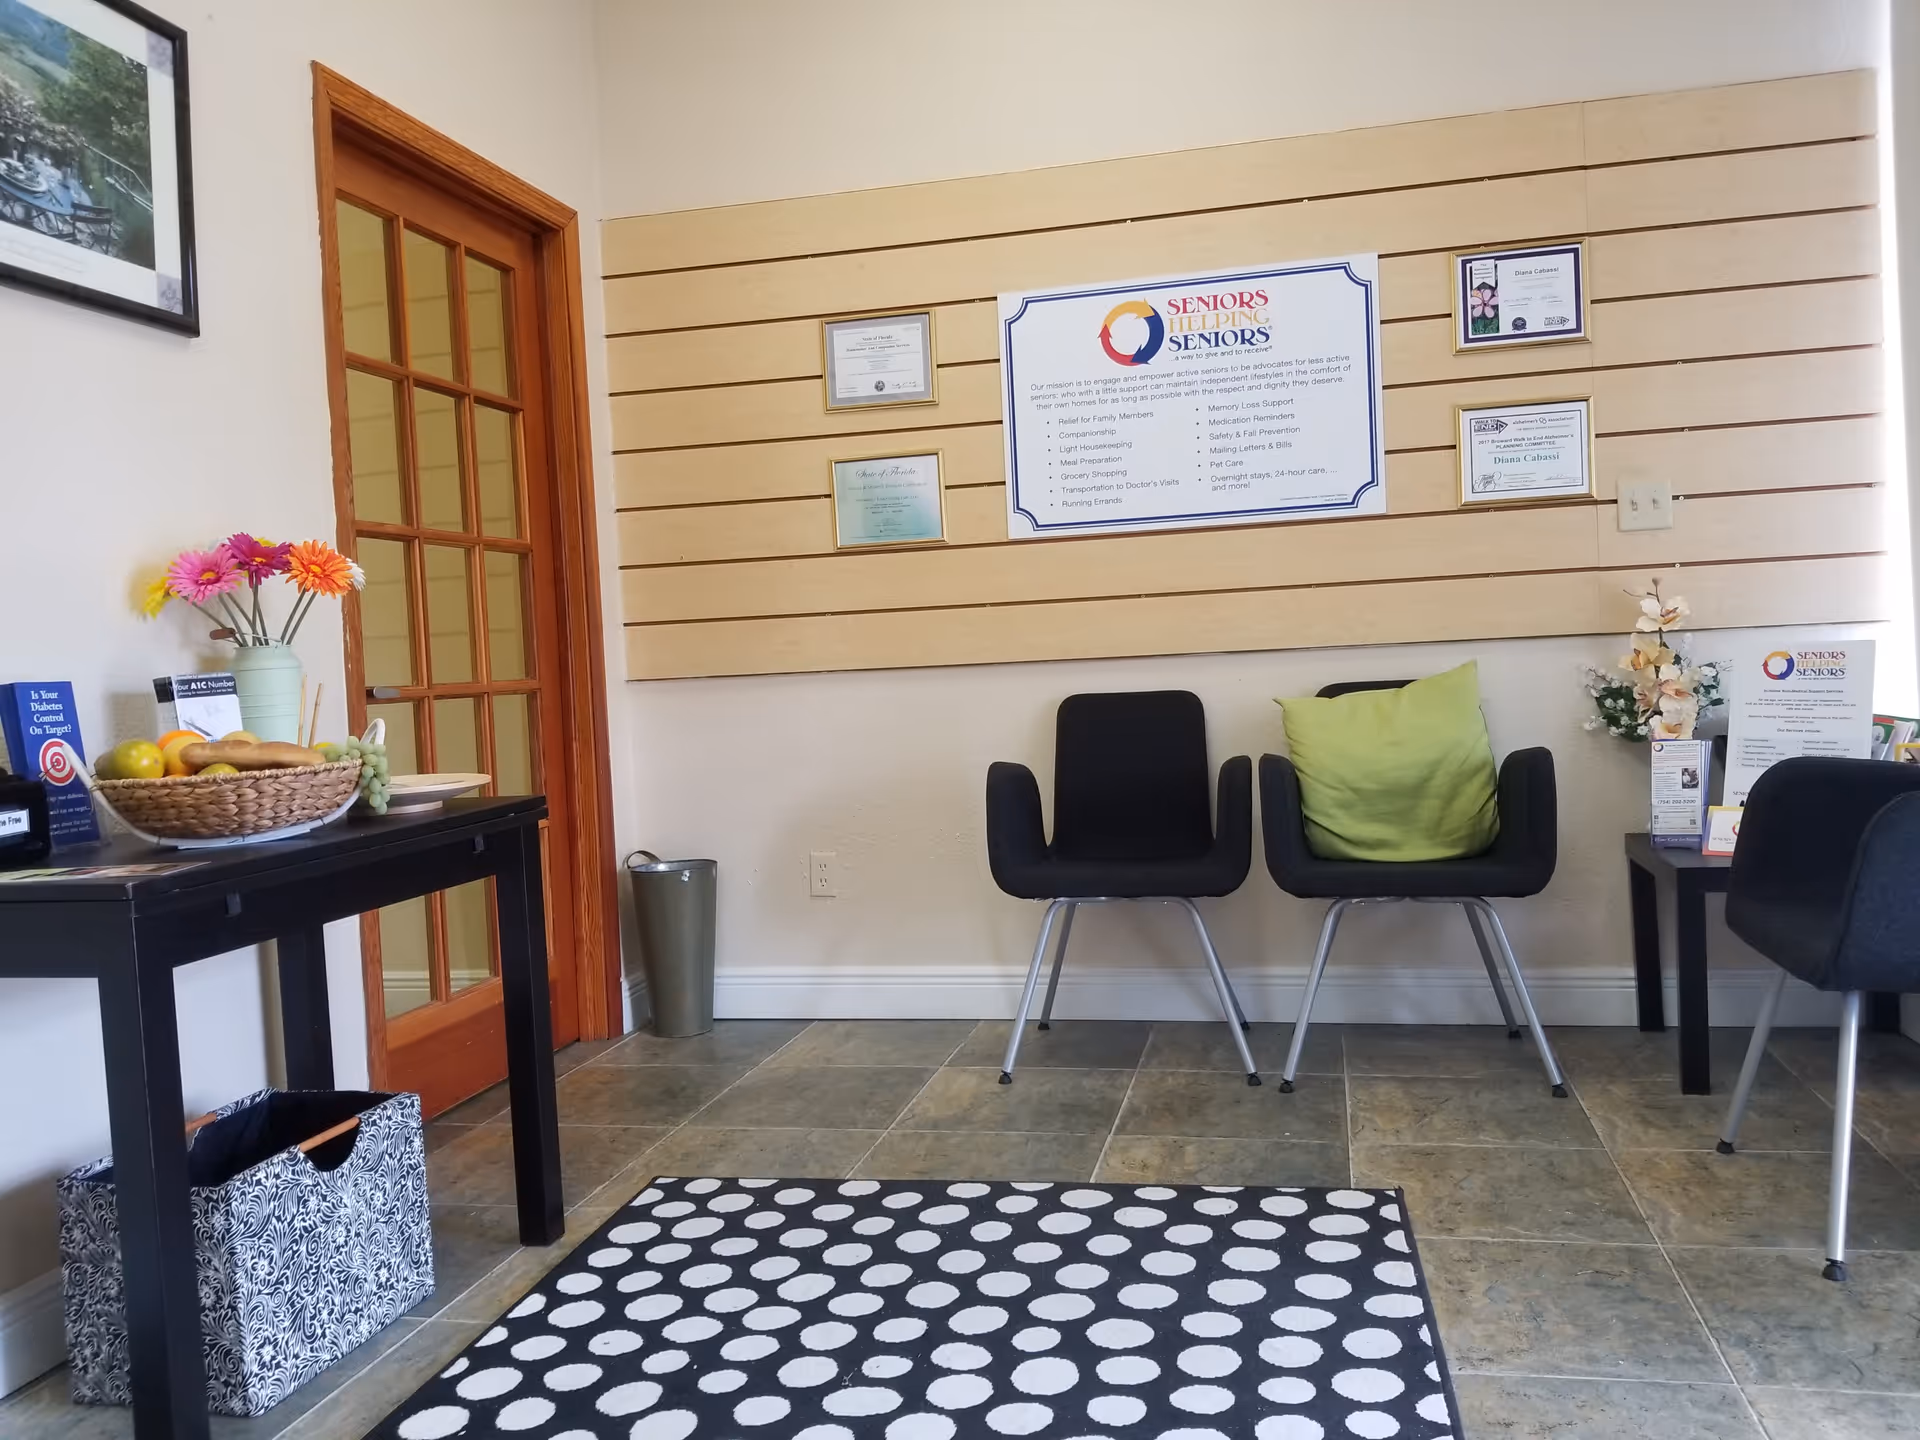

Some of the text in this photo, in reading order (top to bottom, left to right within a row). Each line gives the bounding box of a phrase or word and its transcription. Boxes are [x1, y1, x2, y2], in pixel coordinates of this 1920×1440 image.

[1167, 290, 1268, 315] SENIORS
[1169, 308, 1270, 333] HELPING
[1205, 350, 1218, 360] give
[1046, 382, 1073, 390] mission
[1094, 377, 1120, 386] engage
[1123, 374, 1137, 382] and
[1139, 372, 1174, 382] empower
[1176, 369, 1199, 378] active
[1201, 366, 1228, 375] seniors
[1241, 362, 1250, 371] be
[1253, 360, 1293, 370] advocates
[1295, 358, 1306, 366] for
[1308, 356, 1324, 364] less
[1326, 354, 1350, 363] active
[1061, 390, 1076, 398] who
[1078, 388, 1093, 396] with
[1102, 386, 1117, 395] little
[1119, 384, 1148, 394] support
[1166, 380, 1198, 388] maintain
[1200, 375, 1248, 385] independent
[1250, 371, 1284, 381] lifestyles
[1295, 367, 1308, 376] the
[1310, 366, 1340, 375] comfort
[1343, 364, 1351, 372] of
[1072, 398, 1096, 407] homes
[1121, 394, 1137, 403] long
[1150, 390, 1181, 401] possible
[1184, 388, 1199, 397] with
[1202, 386, 1214, 395] the
[1216, 384, 1245, 395] respect
[1247, 382, 1262, 391] and
[1264, 379, 1290, 390] dignity
[1292, 378, 1308, 388] they
[1208, 398, 1294, 412] Memory Loss Support
[1058, 417, 1078, 426] Relief
[1092, 414, 1116, 423] Family
[1119, 411, 1154, 420] Members
[1209, 413, 1295, 426] Medication Reminders
[1059, 428, 1116, 439] Companionship
[1209, 431, 1233, 441] Safety
[1244, 429, 1257, 437] Fall
[1259, 426, 1300, 436] Prevention
[1060, 440, 1132, 454] Light Housekeeping
[1210, 446, 1237, 454] Mailing
[1239, 443, 1266, 452] Letters
[1276, 440, 1292, 449] Bills
[1080, 455, 1122, 465] Preparation
[1210, 459, 1244, 468] Pet Care
[1494, 452, 1560, 464] Diana Cabassi
[856, 466, 916, 479] State of Florida
[1061, 469, 1127, 480] Grocery Shopping
[1210, 473, 1248, 483] Overnight
[1250, 470, 1272, 480] stays,
[1275, 468, 1305, 478] 24-hour
[1061, 484, 1114, 494] Transportation
[1126, 480, 1158, 489] Doctor's
[1212, 483, 1226, 491] and
[1062, 496, 1122, 508] Running Errands
[1796, 651, 1846, 660] SENIORS
[190, 681, 207, 690] A1C
[208, 679, 234, 688] Number
[30, 691, 58, 699] Is Your
[30, 702, 63, 711] Diabetes
[34, 713, 64, 723] Control
[30, 724, 71, 736] On Target?
[8, 816, 22, 825] Free
